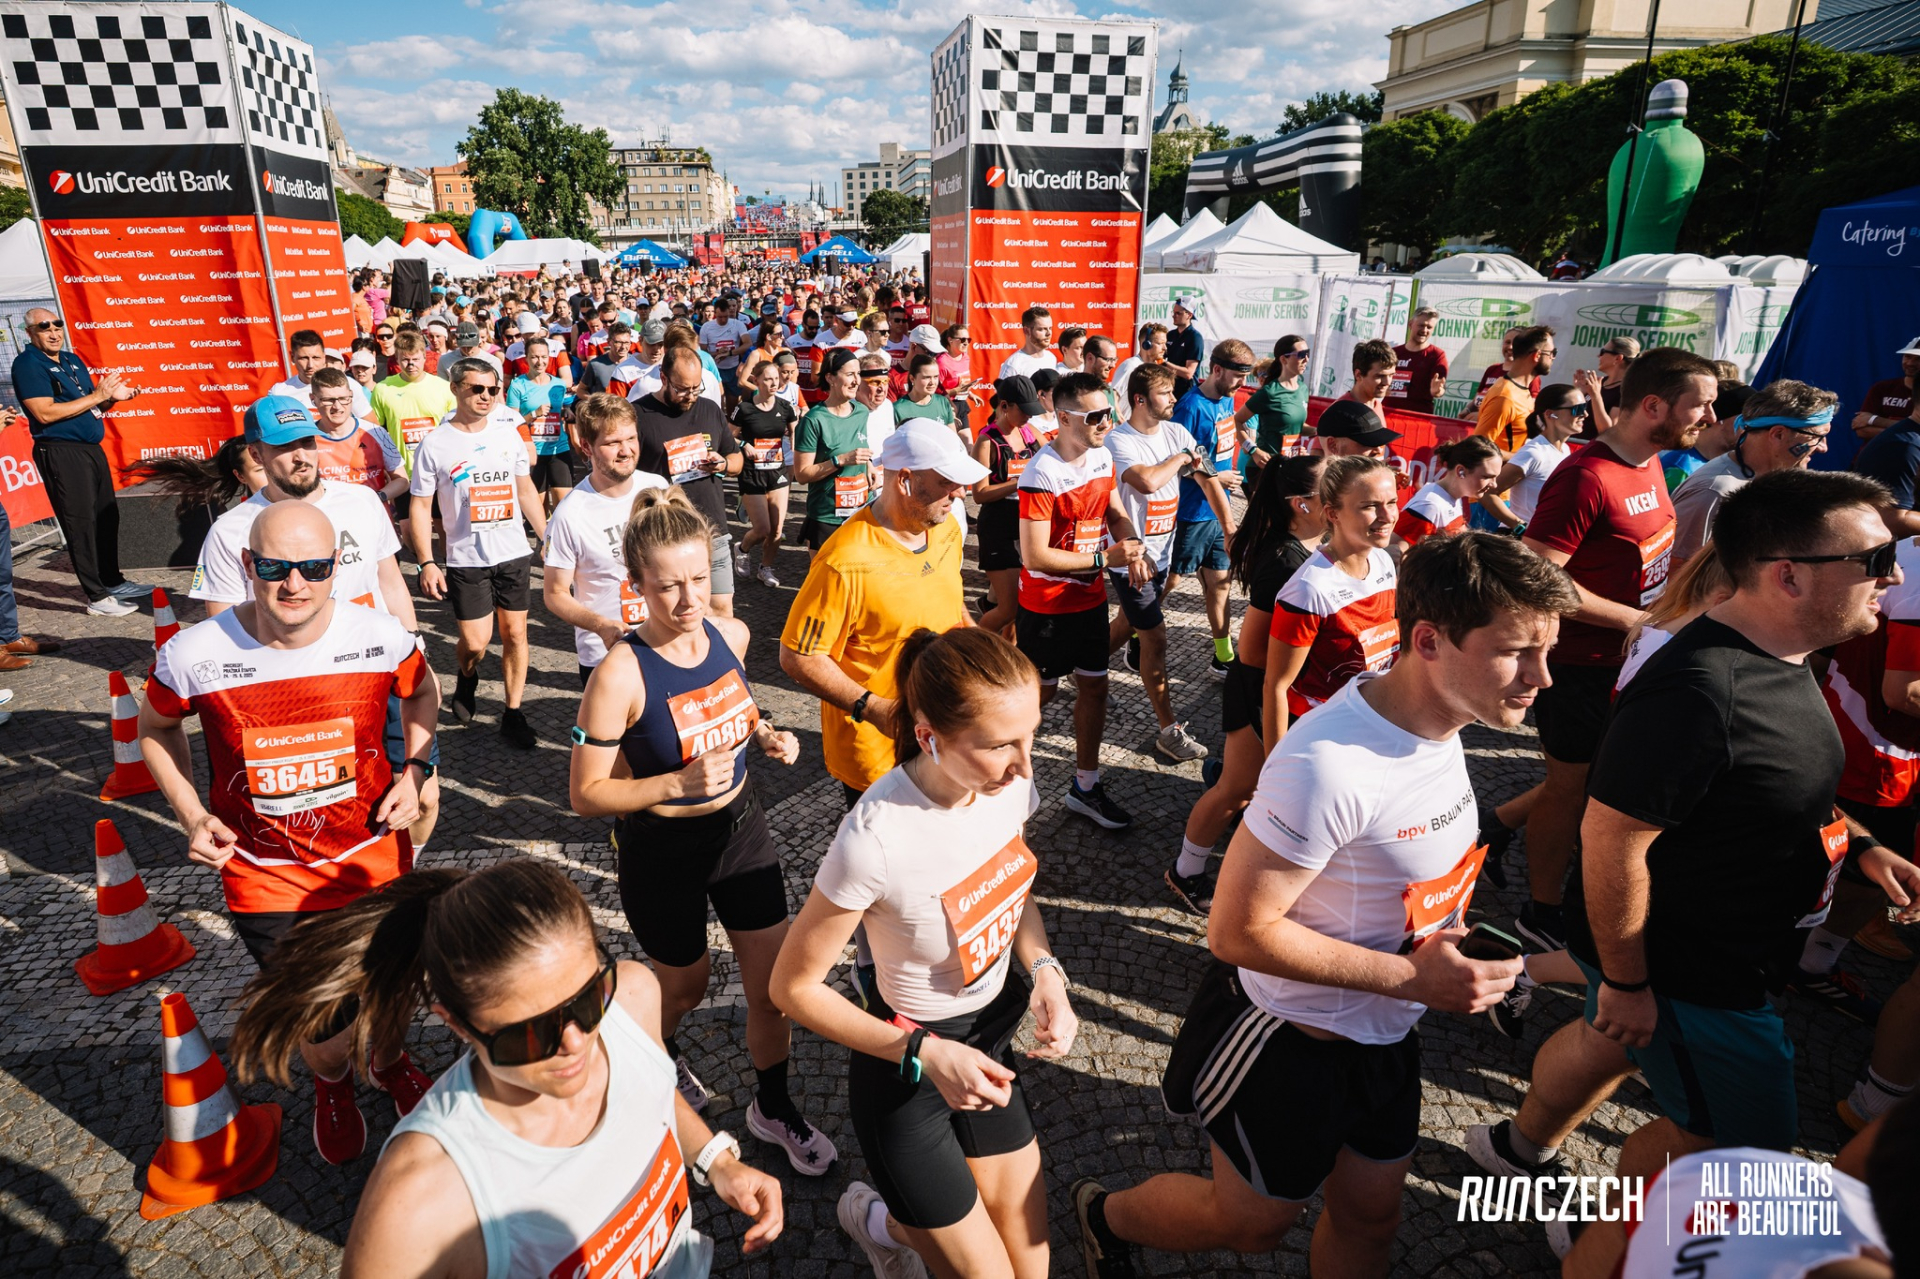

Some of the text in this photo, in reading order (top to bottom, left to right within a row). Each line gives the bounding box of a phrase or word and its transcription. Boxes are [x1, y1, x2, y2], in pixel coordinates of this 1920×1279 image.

[77, 169, 232, 194] UniCredit Bank
[272, 173, 329, 201] UniCredit Bank
[1007, 169, 1130, 190] UniCredit Bank
[1842, 220, 1906, 256] Catering
[1142, 304, 1169, 319] HNNY
[1234, 303, 1309, 319] JOHNNY SERVIS
[1, 455, 43, 492] Ba
[318, 465, 350, 474] ACING
[473, 471, 509, 483] EGAP
[840, 493, 864, 506] 3574
[1625, 490, 1659, 516] IKEM
[477, 505, 505, 520] 3772
[1150, 519, 1173, 533] 2745
[337, 551, 362, 566] ACK
[193, 566, 203, 589] IKEA
[628, 603, 649, 621] 34
[693, 681, 740, 712] UniCredit Bank
[269, 729, 343, 747] UniCredit Bank
[691, 713, 748, 757] 4086
[256, 758, 348, 793] 3645 A
[1397, 789, 1474, 840] bpv BRAUN PAR
[969, 854, 1027, 905] UniCredit Bank
[589, 1158, 672, 1268] UniCredit Bank
